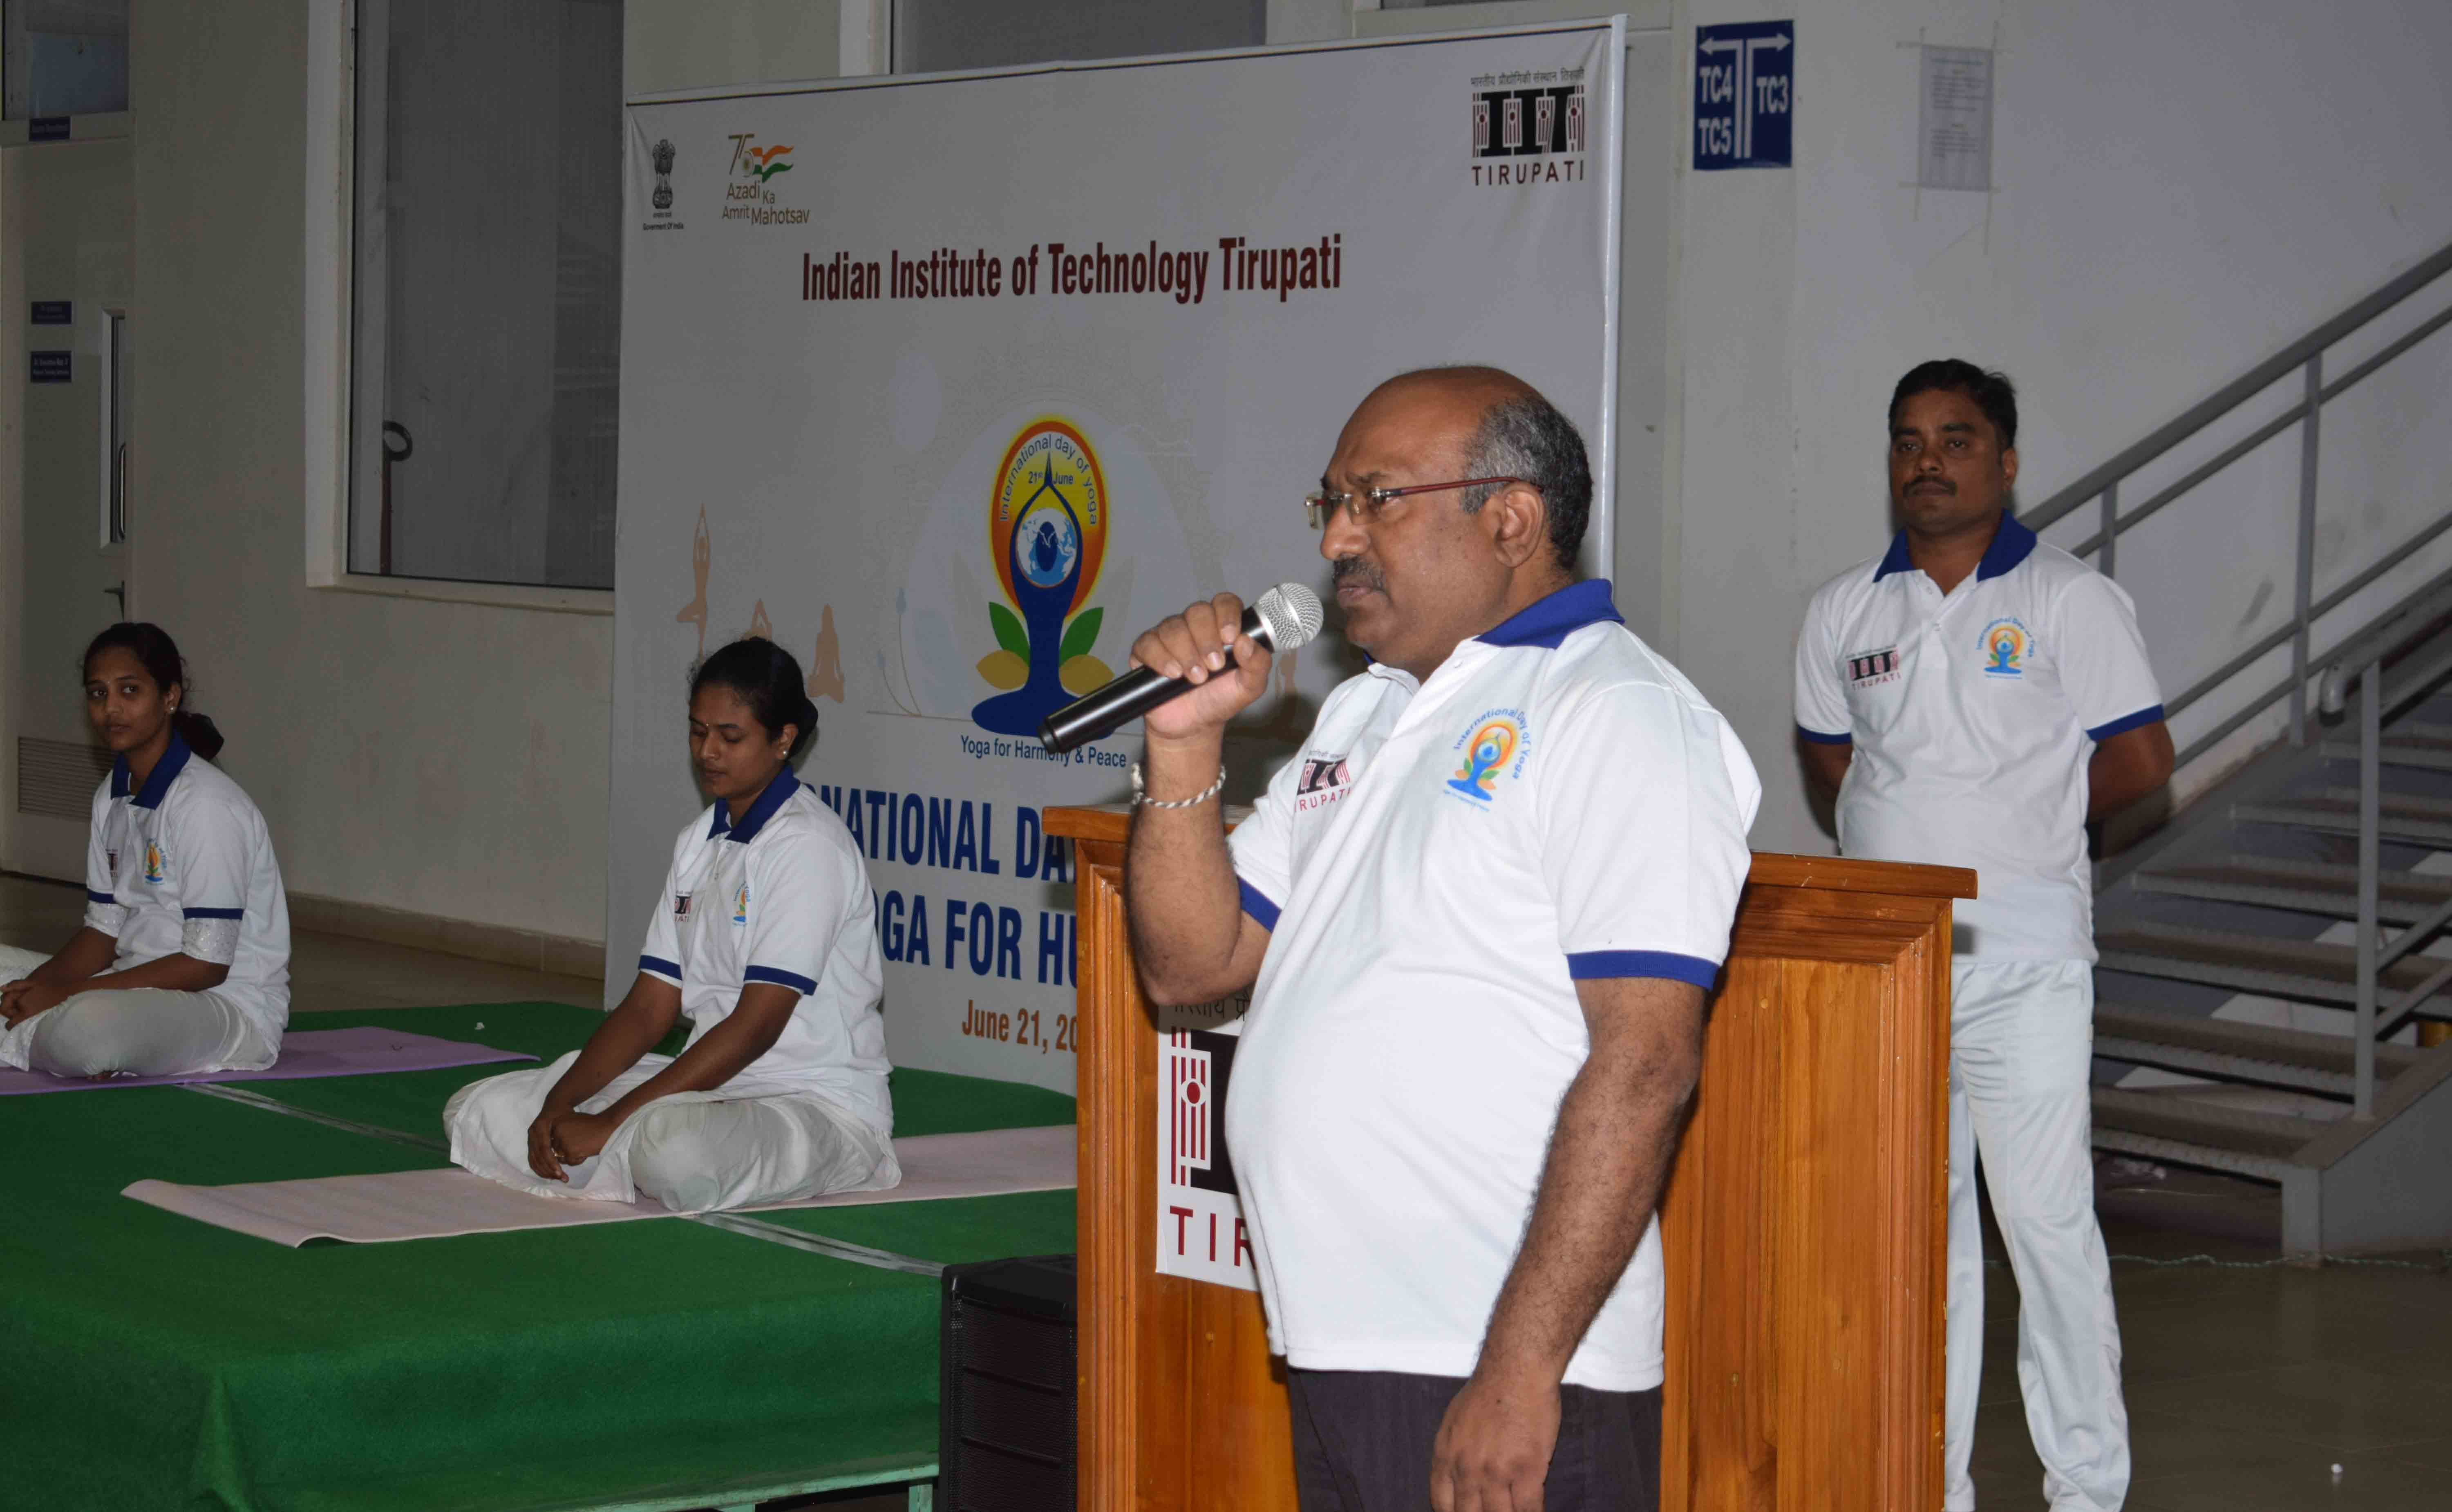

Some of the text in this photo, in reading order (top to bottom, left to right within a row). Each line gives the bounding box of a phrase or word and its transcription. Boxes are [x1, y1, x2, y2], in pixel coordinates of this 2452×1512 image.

[1700, 65, 1733, 103] TC4
[1756, 76, 1788, 114] TC3
[1698, 117, 1732, 156] TC5
[726, 180, 775, 204] Azadi Ka
[1472, 160, 1584, 186] TIRUPATI
[722, 205, 810, 226] Amrit Mahotsav
[803, 233, 1341, 305] Indian Institute of Technology Tirupati
[1000, 434, 1097, 525] International day of yoga
[1052, 473, 1074, 485] June
[1851, 672, 1902, 691] TIRUPATI
[1453, 708, 1517, 750] International
[961, 735, 990, 759] Yoga
[994, 738, 1011, 758] for
[1075, 745, 1084, 764] &
[1088, 746, 1127, 767] Peace
[1015, 806, 1077, 883] DA
[945, 899, 1022, 980] FOR
[962, 1000, 1009, 1042] June
[1017, 1008, 1049, 1054] 21,
